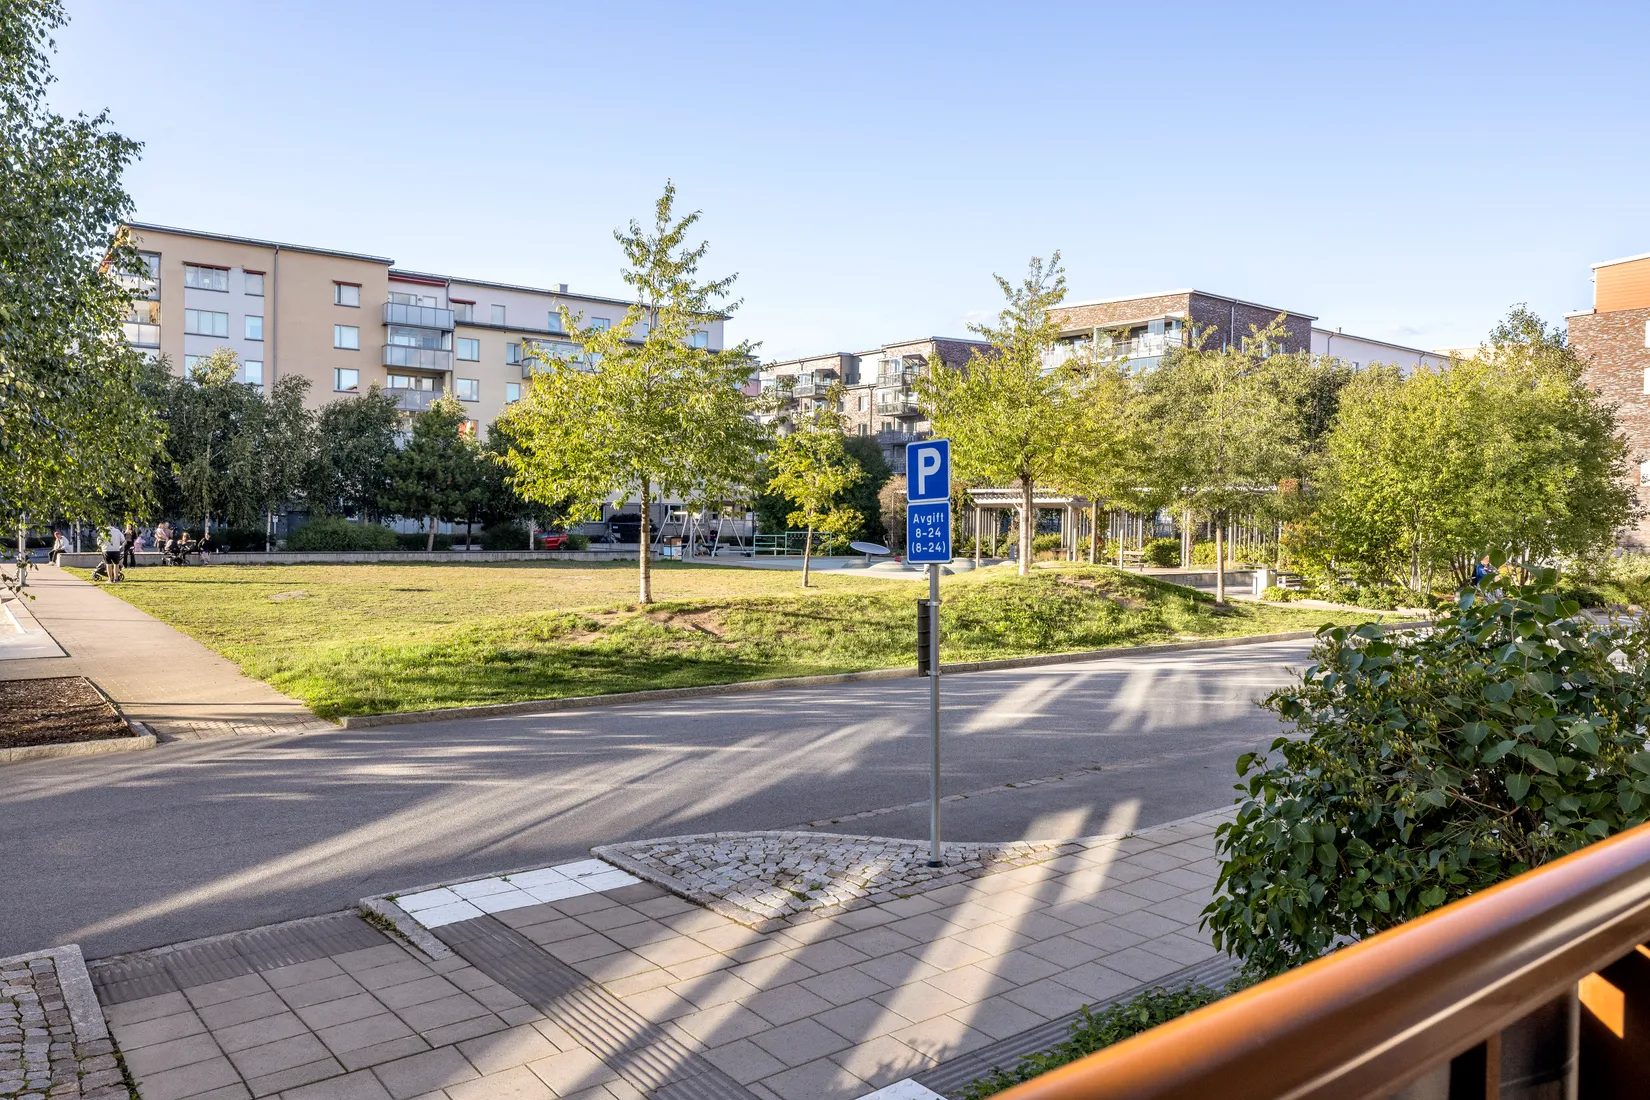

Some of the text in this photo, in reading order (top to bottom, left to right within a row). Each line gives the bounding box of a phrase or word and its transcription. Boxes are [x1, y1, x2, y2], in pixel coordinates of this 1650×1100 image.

[918, 447, 941, 495] P
[913, 512, 944, 525] Avgift
[915, 527, 941, 538] 8-24
[911, 541, 946, 553] (8-24)
